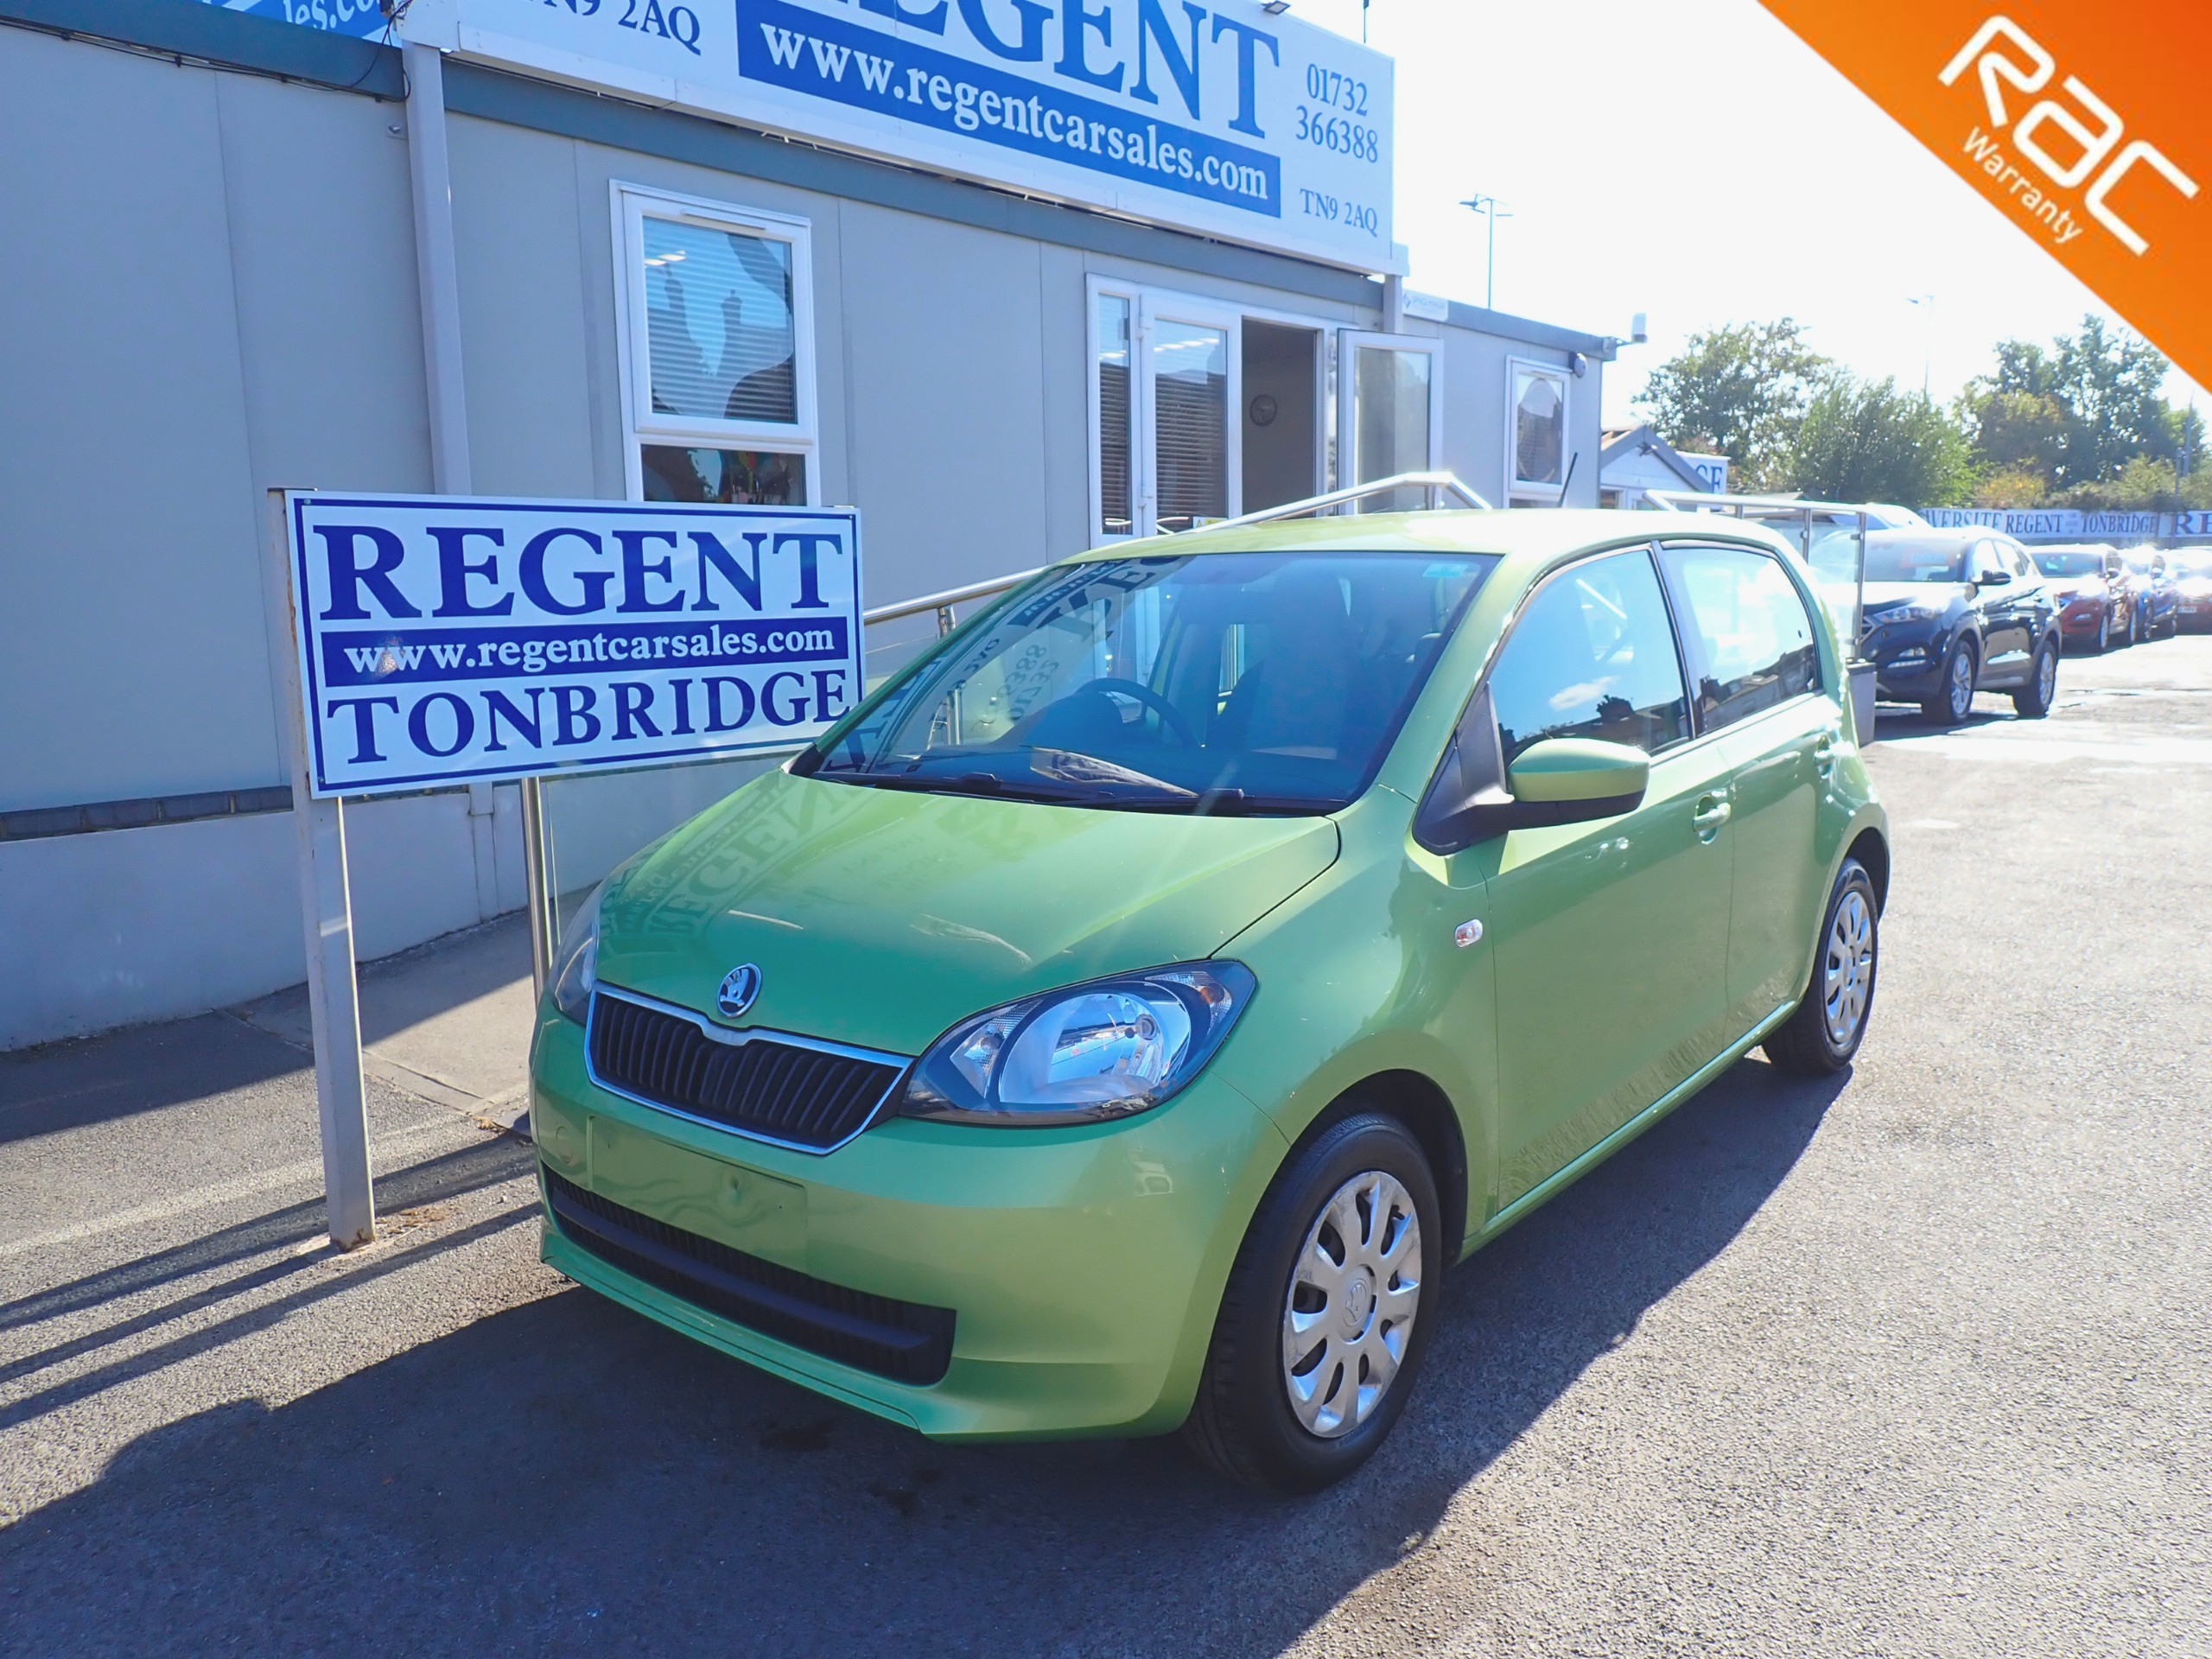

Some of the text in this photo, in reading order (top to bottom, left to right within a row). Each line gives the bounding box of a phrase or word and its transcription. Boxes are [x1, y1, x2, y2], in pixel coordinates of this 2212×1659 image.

[618, 0, 702, 56] 2AQ
[835, 0, 1281, 139] GENT
[1306, 63, 1368, 117] 01732
[760, 22, 1268, 200] www.regentcarsales.com
[1296, 105, 1378, 163] 366388
[1300, 188, 1377, 238] TN9 2AQ
[2005, 513, 2158, 533] REGENT TONBRIDGE
[312, 524, 842, 620] REGENT
[344, 622, 835, 673] www.regentcarsales.com
[327, 668, 851, 765] TONBRIDGE
